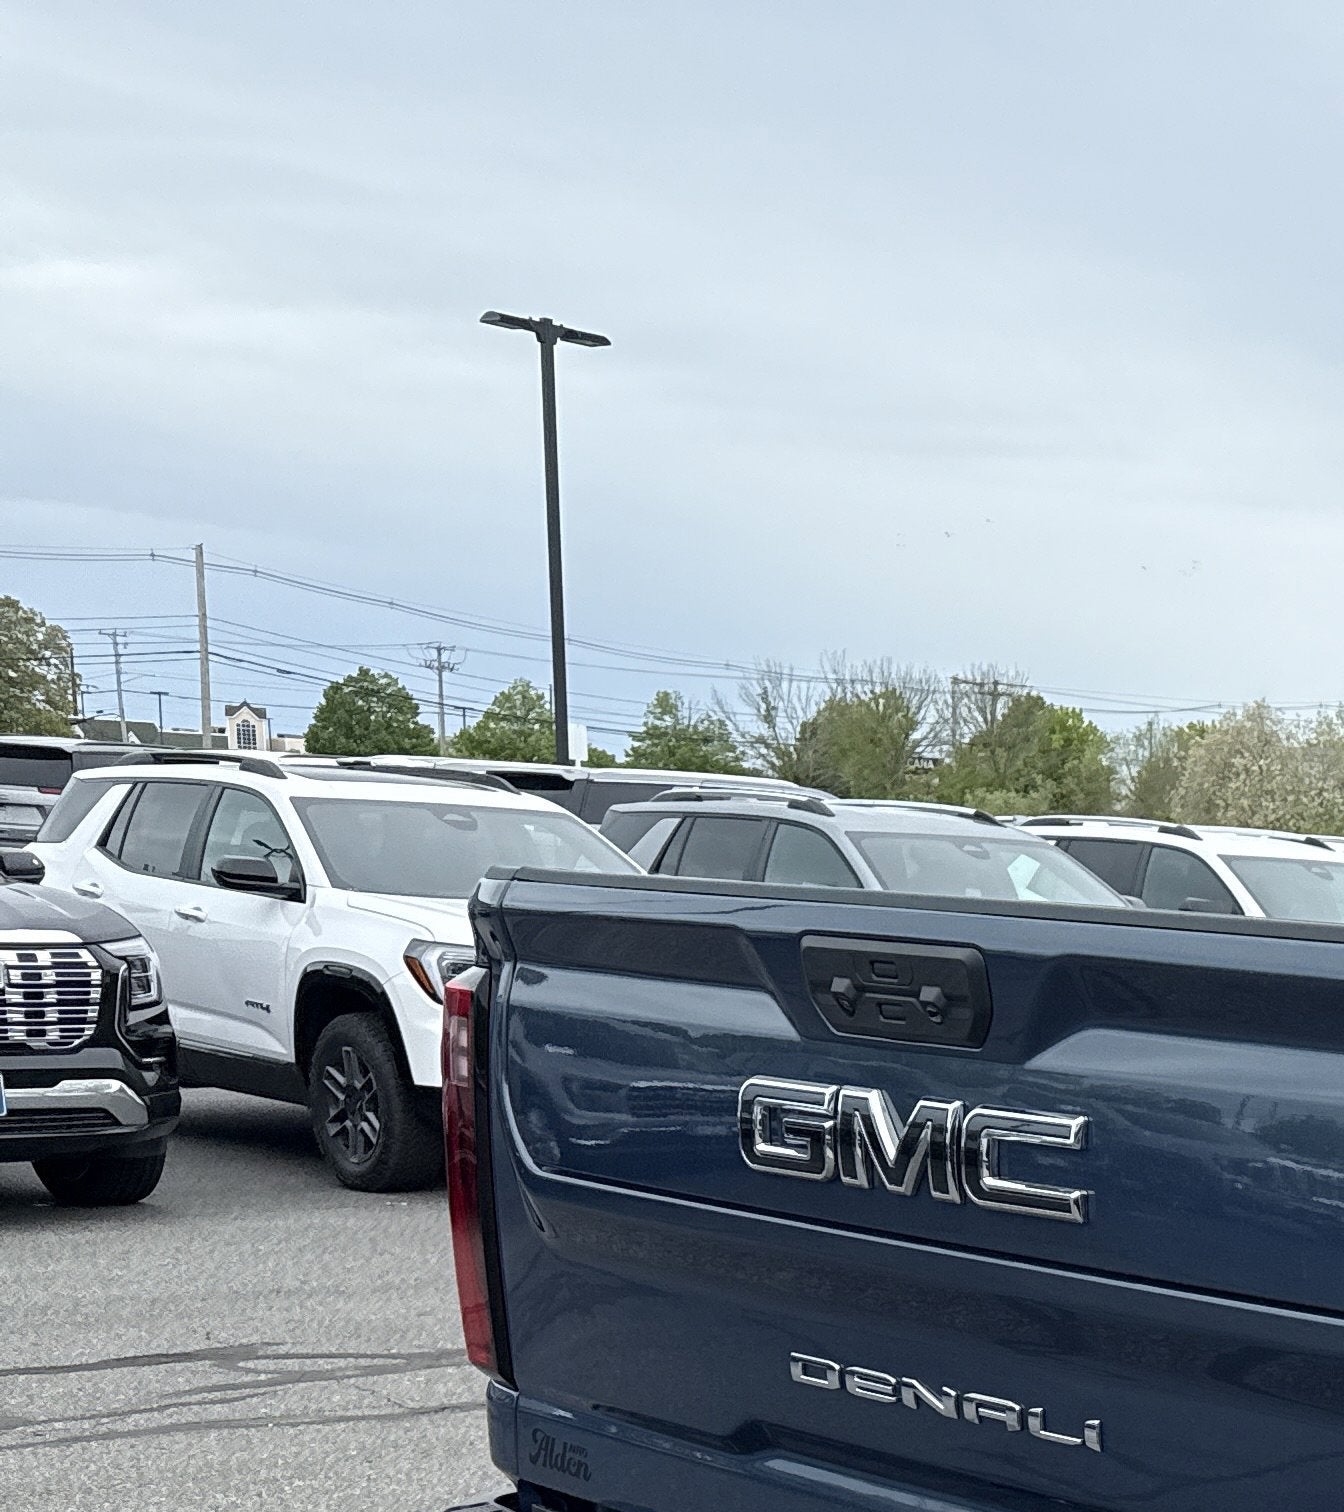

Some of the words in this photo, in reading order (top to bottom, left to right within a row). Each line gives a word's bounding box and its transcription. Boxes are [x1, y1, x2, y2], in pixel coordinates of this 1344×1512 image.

[738, 1074, 1091, 1224] GMC
[790, 1351, 1102, 1452] DENALI
[529, 1427, 592, 1482] Alden
